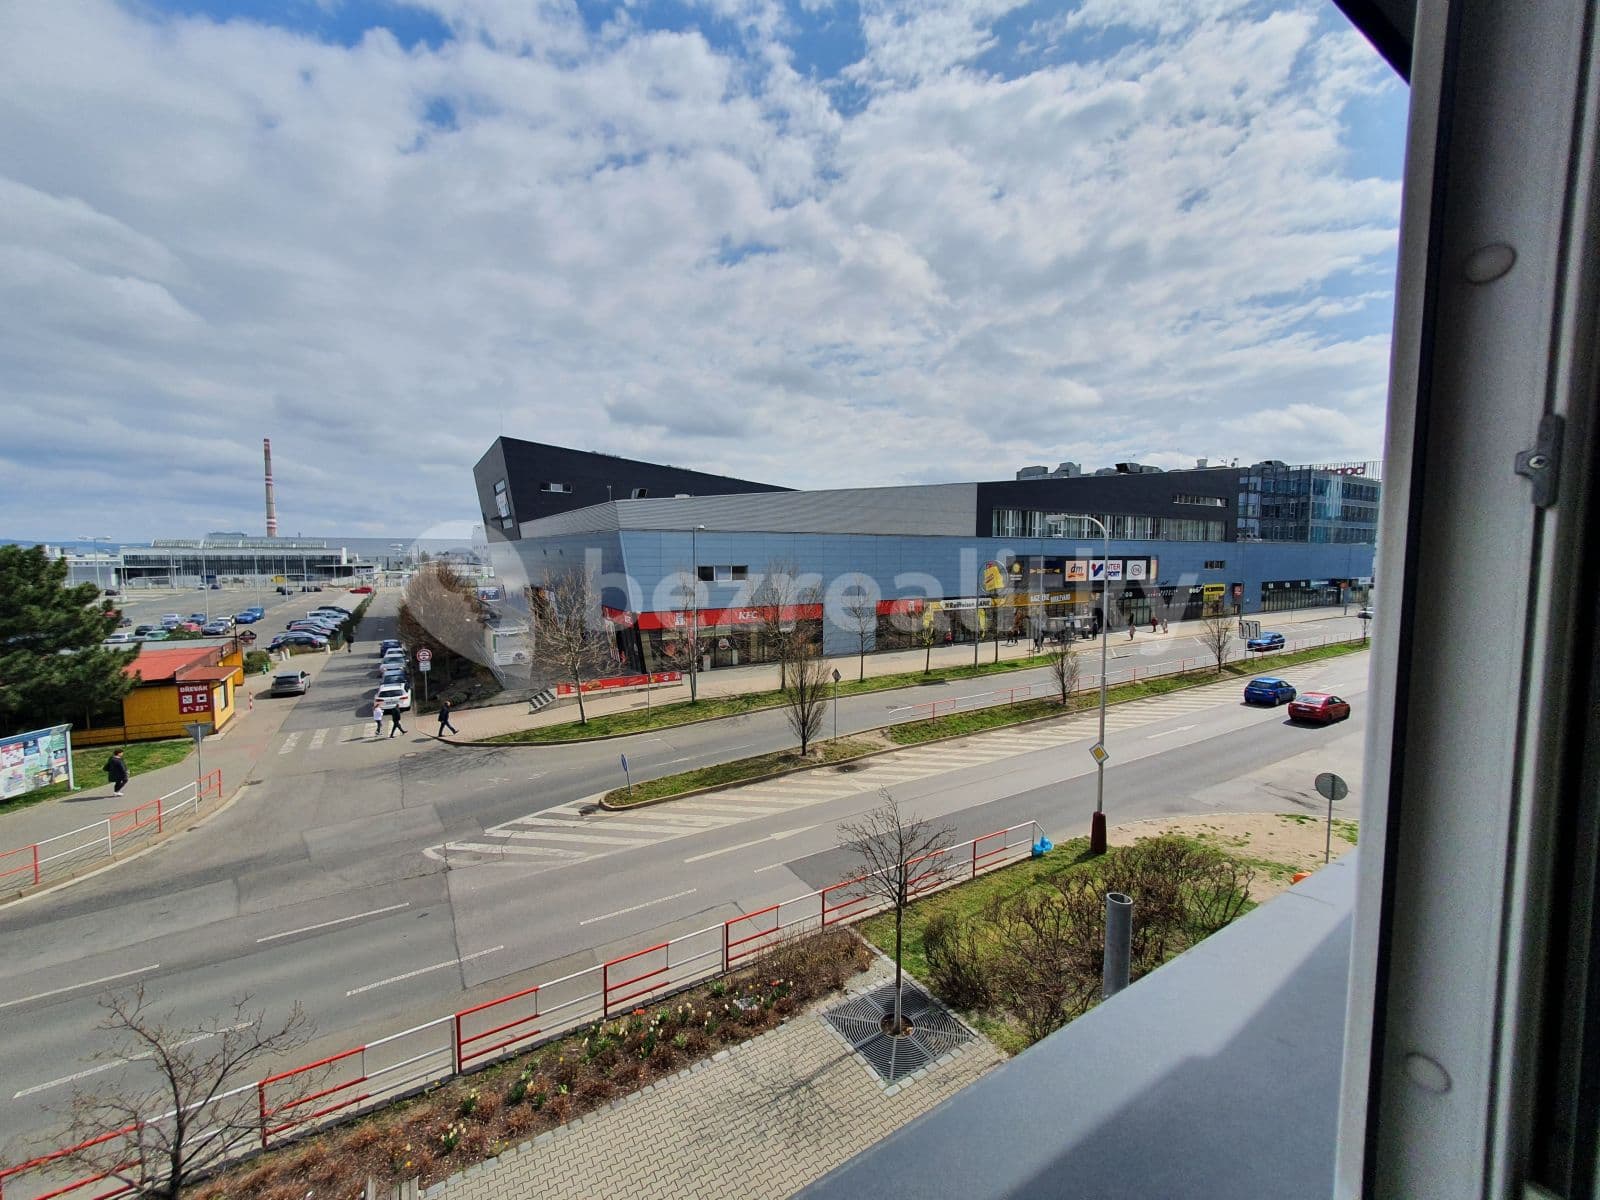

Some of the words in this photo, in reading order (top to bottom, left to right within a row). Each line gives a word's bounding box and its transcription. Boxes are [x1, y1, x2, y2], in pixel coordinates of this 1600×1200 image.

[1070, 562, 1083, 573] dm
[1107, 563, 1121, 571] NTER
[738, 610, 758, 620] KFC
